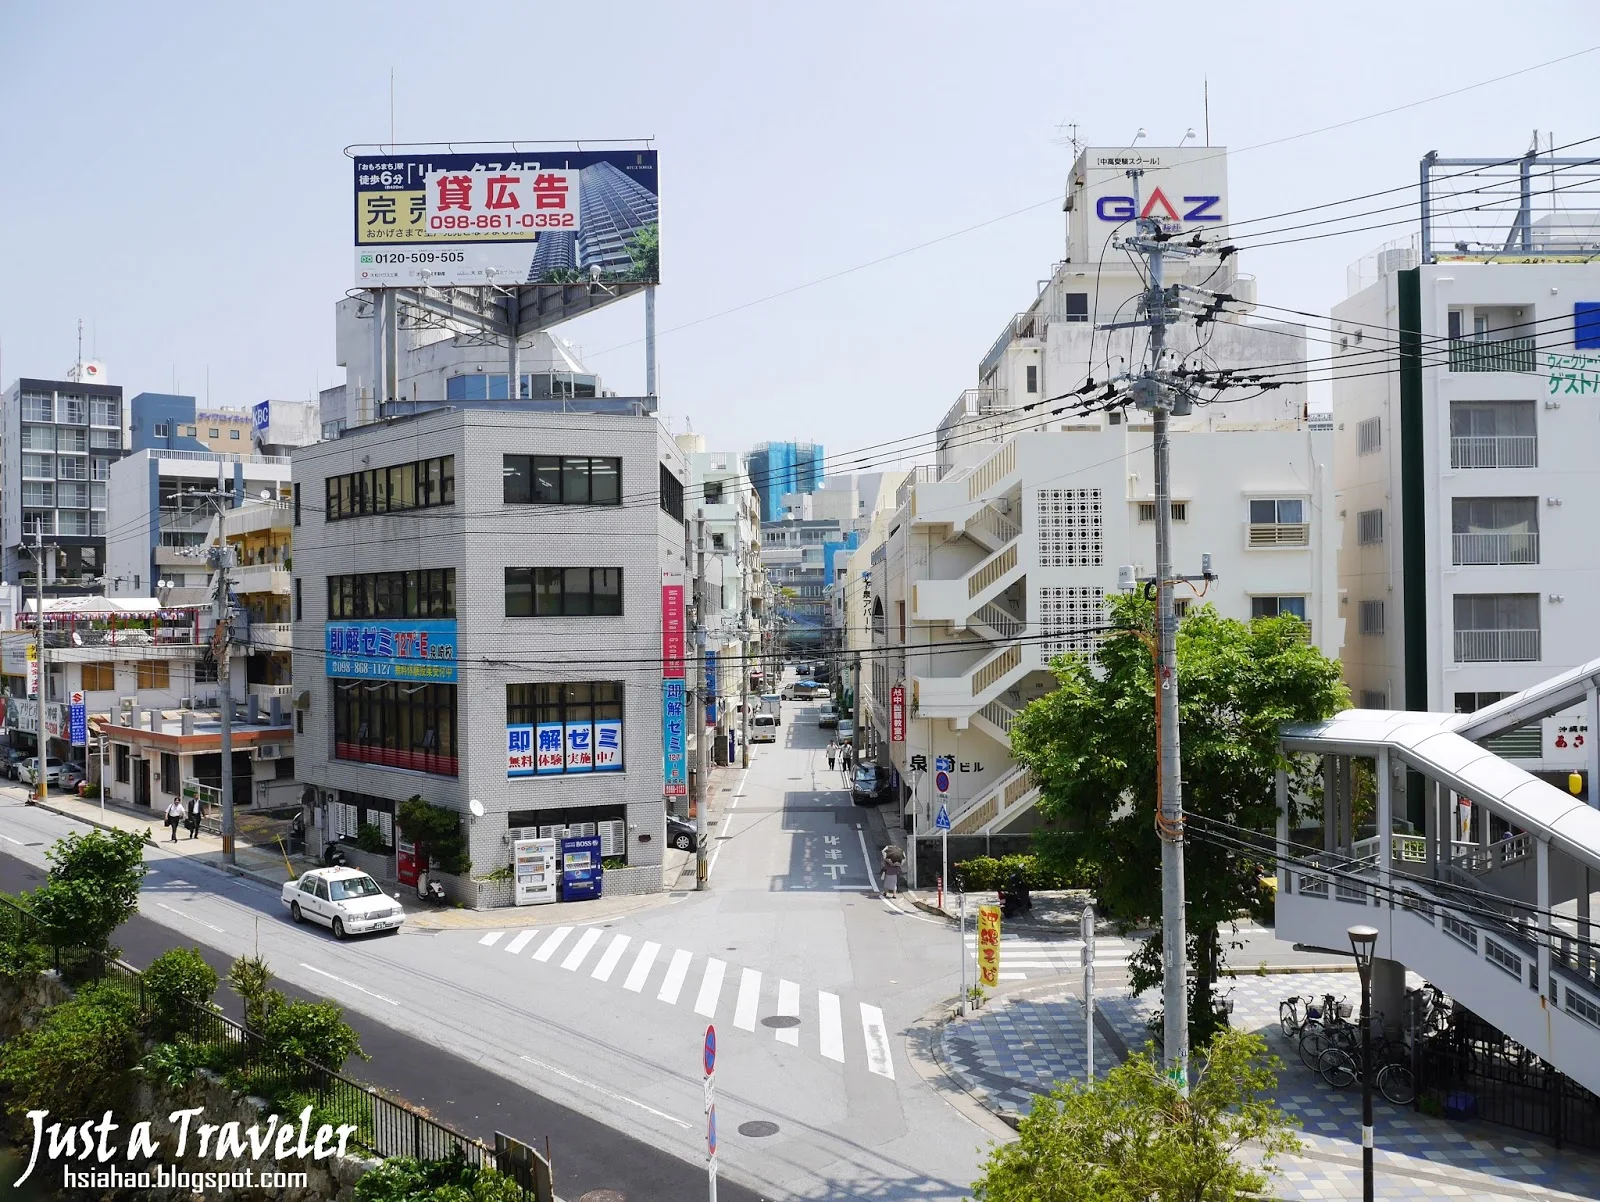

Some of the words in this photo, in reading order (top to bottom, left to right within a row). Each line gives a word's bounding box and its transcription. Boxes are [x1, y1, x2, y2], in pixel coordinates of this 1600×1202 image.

[359, 171, 404, 186] 徒歩6分
[436, 173, 570, 212] 貸広告
[430, 212, 575, 230] 098-861-0352
[375, 251, 465, 264] 0120-509-505
[252, 407, 269, 427] KBC
[330, 627, 393, 657] 即解ゼミ
[667, 684, 682, 751] 即解ゼミ
[508, 728, 619, 753] 即解ゼミ
[508, 751, 615, 768] 無料体験実施中!
[575, 840, 592, 848] BOSS
[980, 909, 999, 983] 沖縄そば
